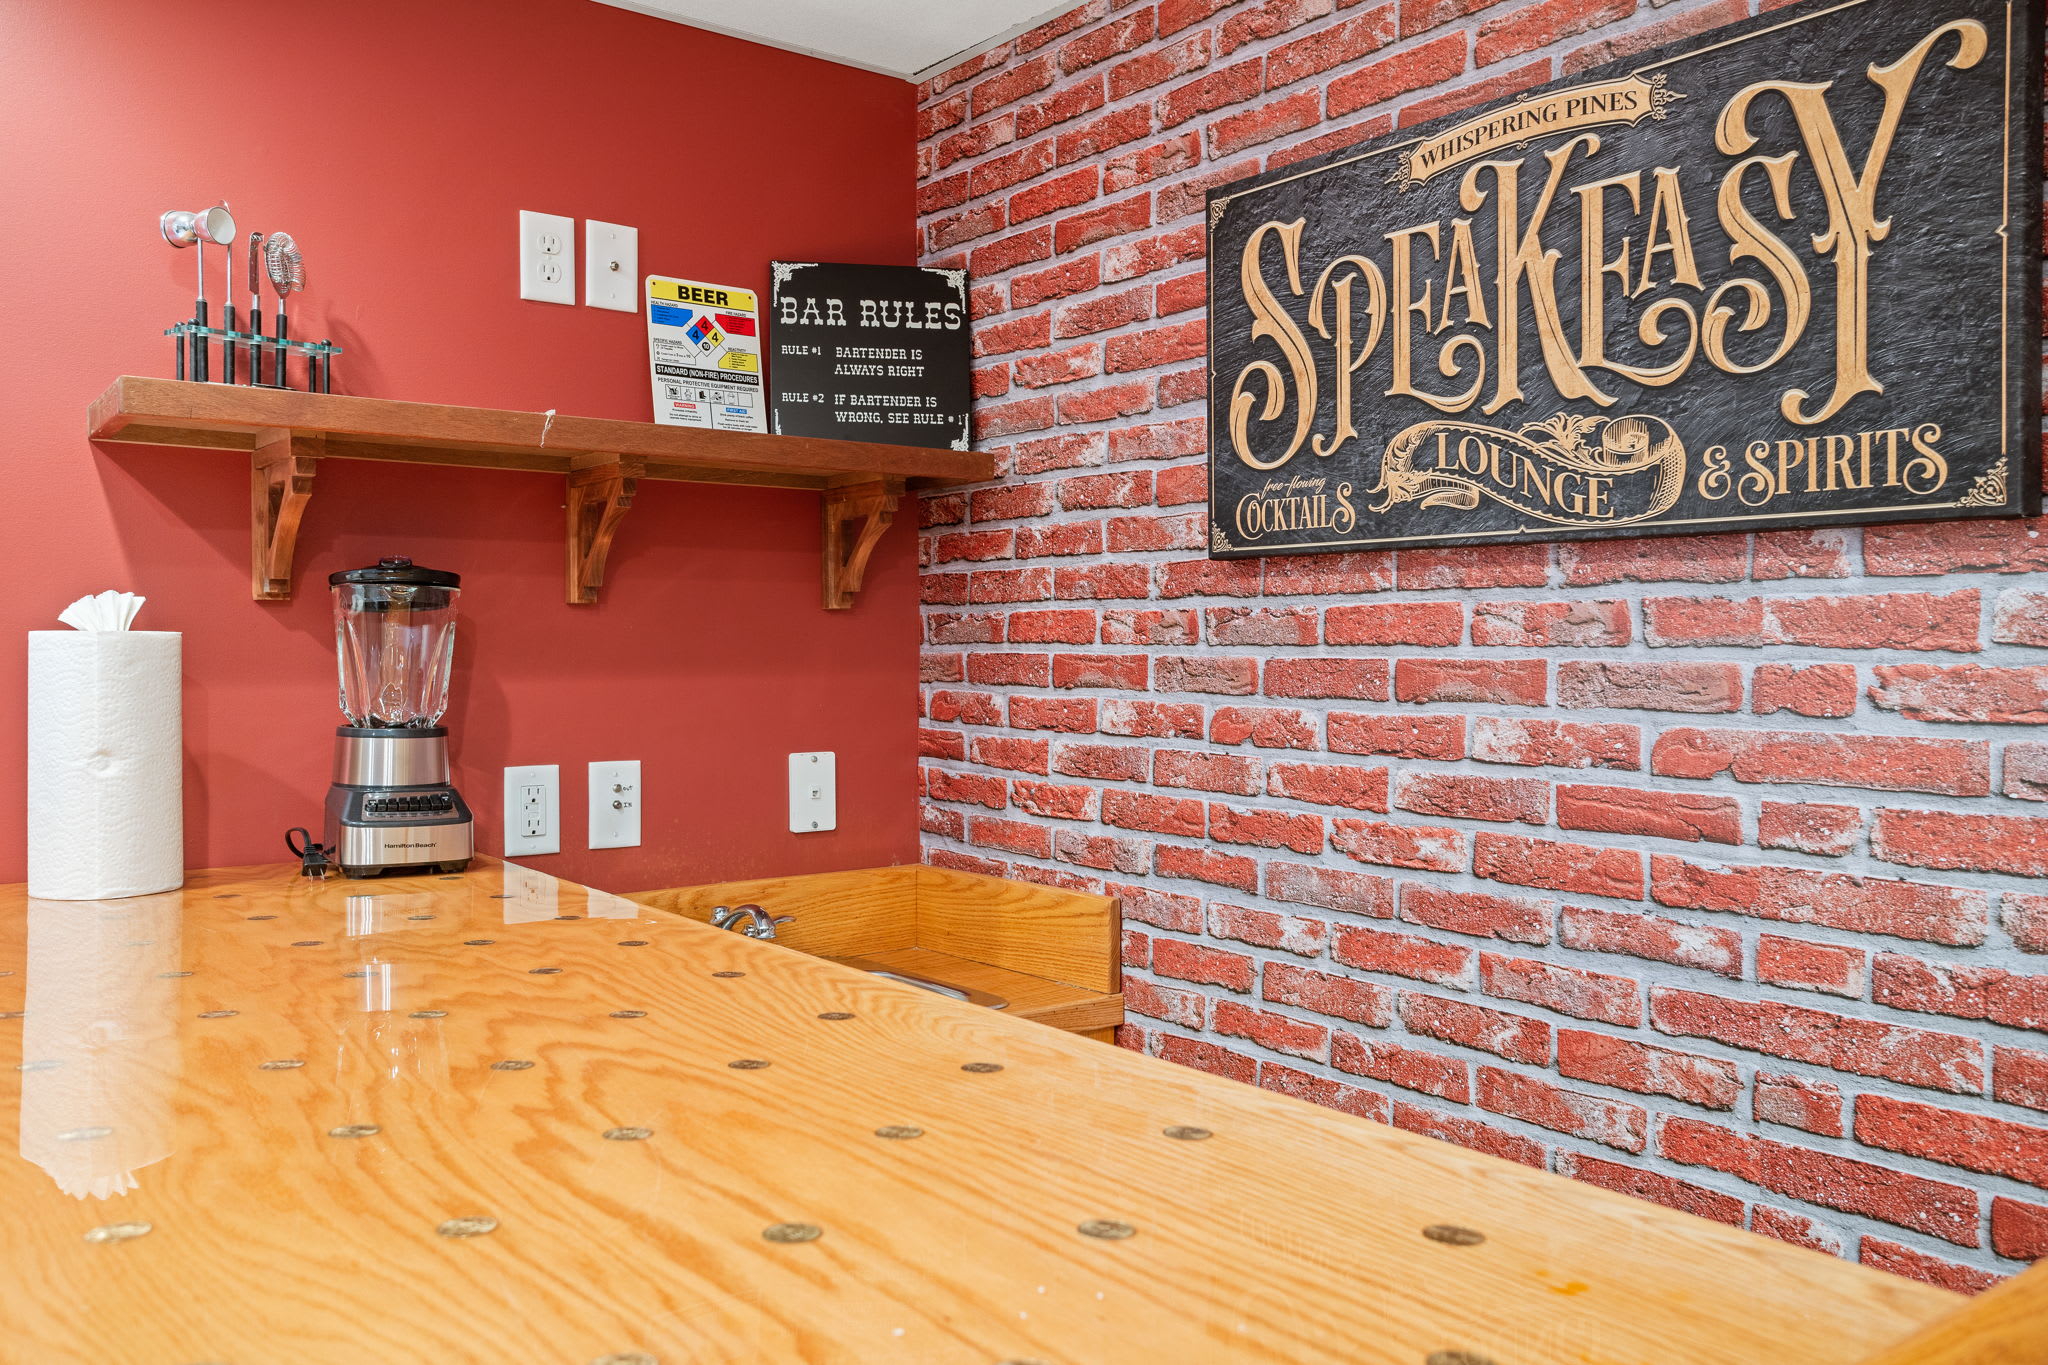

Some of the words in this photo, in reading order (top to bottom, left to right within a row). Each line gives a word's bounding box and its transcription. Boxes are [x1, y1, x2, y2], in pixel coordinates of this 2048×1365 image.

[1420, 104, 1558, 168] WHISPERING
[1566, 90, 1638, 118] PINES
[678, 285, 728, 306] BEER
[780, 296, 847, 327] BAR
[860, 299, 961, 330] RULES
[702, 321, 709, 331] 4
[692, 332, 699, 340] 4
[712, 332, 719, 342] 4
[781, 345, 809, 355] RULE
[835, 347, 907, 360] BARTENDER
[911, 349, 923, 360] IS
[656, 366, 688, 376] STANDARD
[689, 371, 720, 381] (NON-FIRE)
[720, 374, 758, 384] PROCEDURES
[834, 364, 884, 376] ALWAYS
[887, 365, 925, 377] RIGHT
[657, 377, 682, 385] PERSONAL
[682, 380, 710, 388] PROTECTIVE
[781, 392, 809, 403] RULE
[834, 393, 846, 405] IF
[850, 394, 922, 407] BARTENDER
[925, 396, 938, 408] IS
[887, 412, 910, 424] SEE
[913, 413, 944, 425] RULE
[1698, 445, 1731, 500] &
[1737, 423, 1948, 507] SPIRITS
[1434, 432, 1614, 518] LOUNGE
[1235, 482, 1356, 540] COCKTAILS
